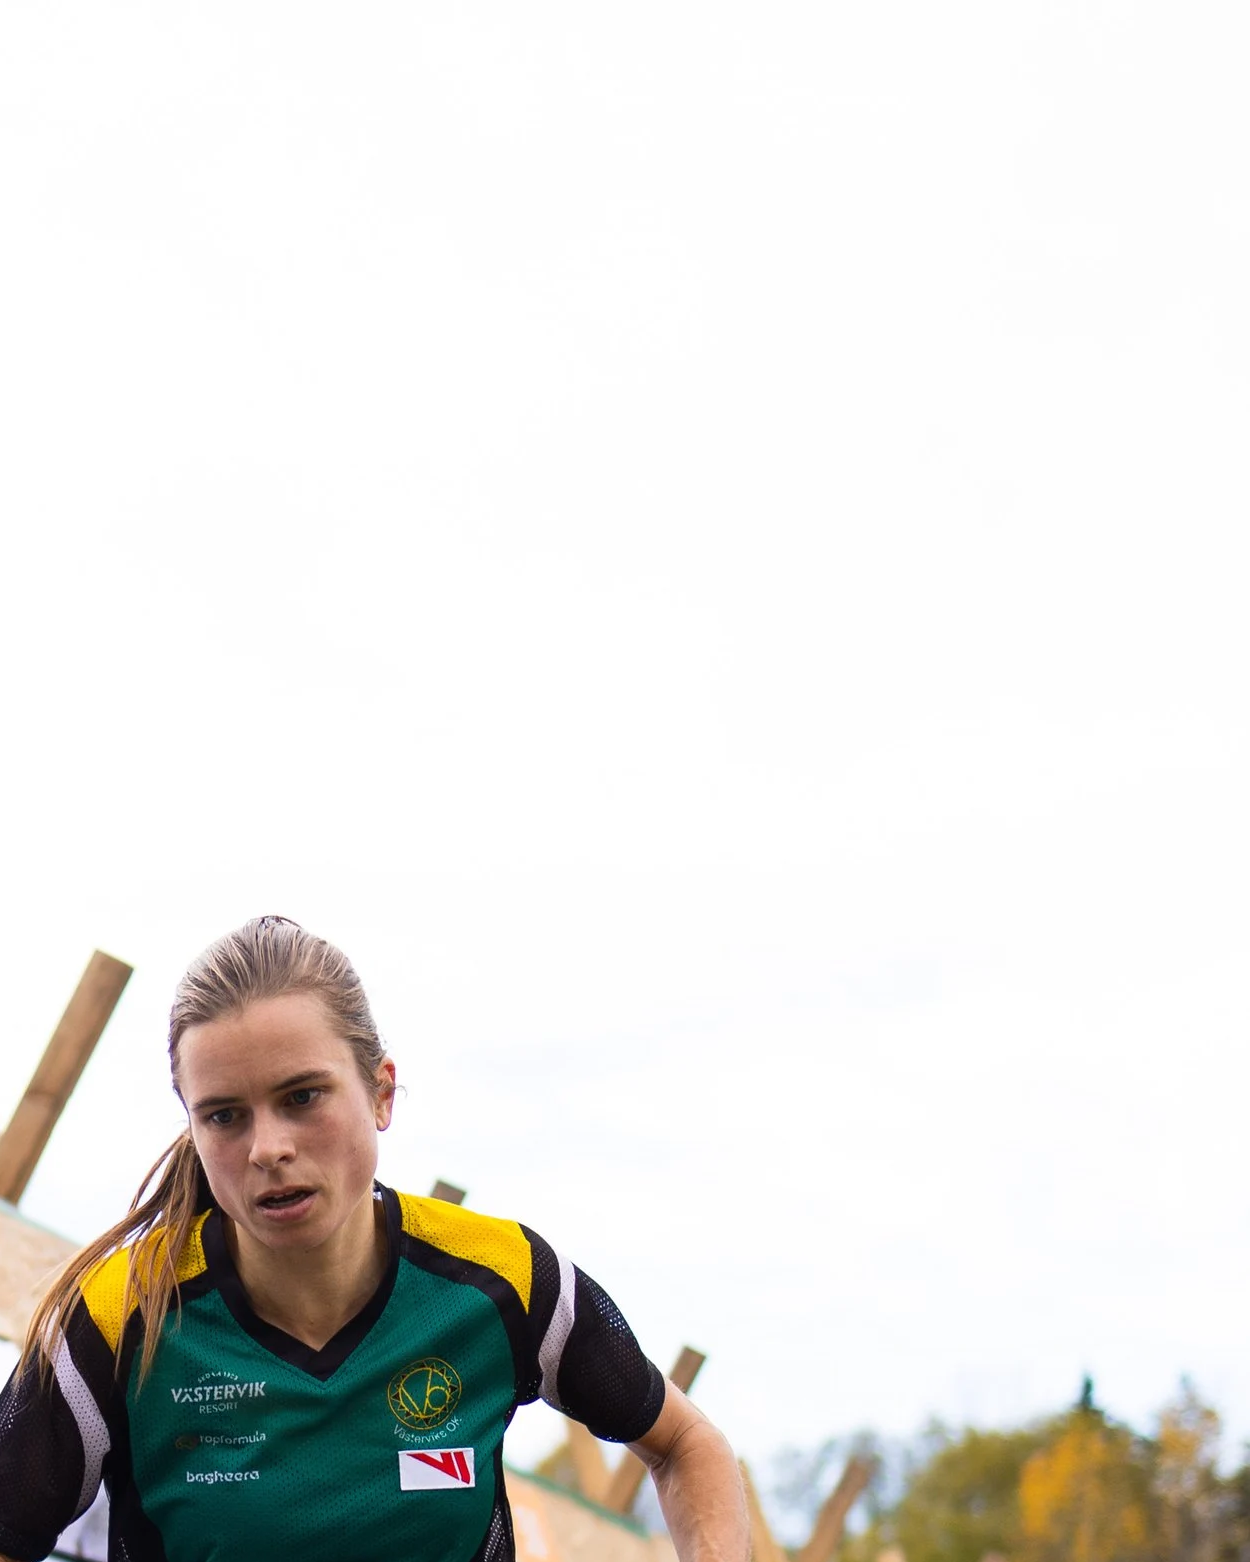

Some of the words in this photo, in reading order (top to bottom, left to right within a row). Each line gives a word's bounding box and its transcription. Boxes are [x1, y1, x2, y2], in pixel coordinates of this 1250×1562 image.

[171, 1381, 266, 1403] VÄSTERVIK
[199, 1402, 238, 1414] RESORT
[186, 1470, 260, 1485] bagheera
